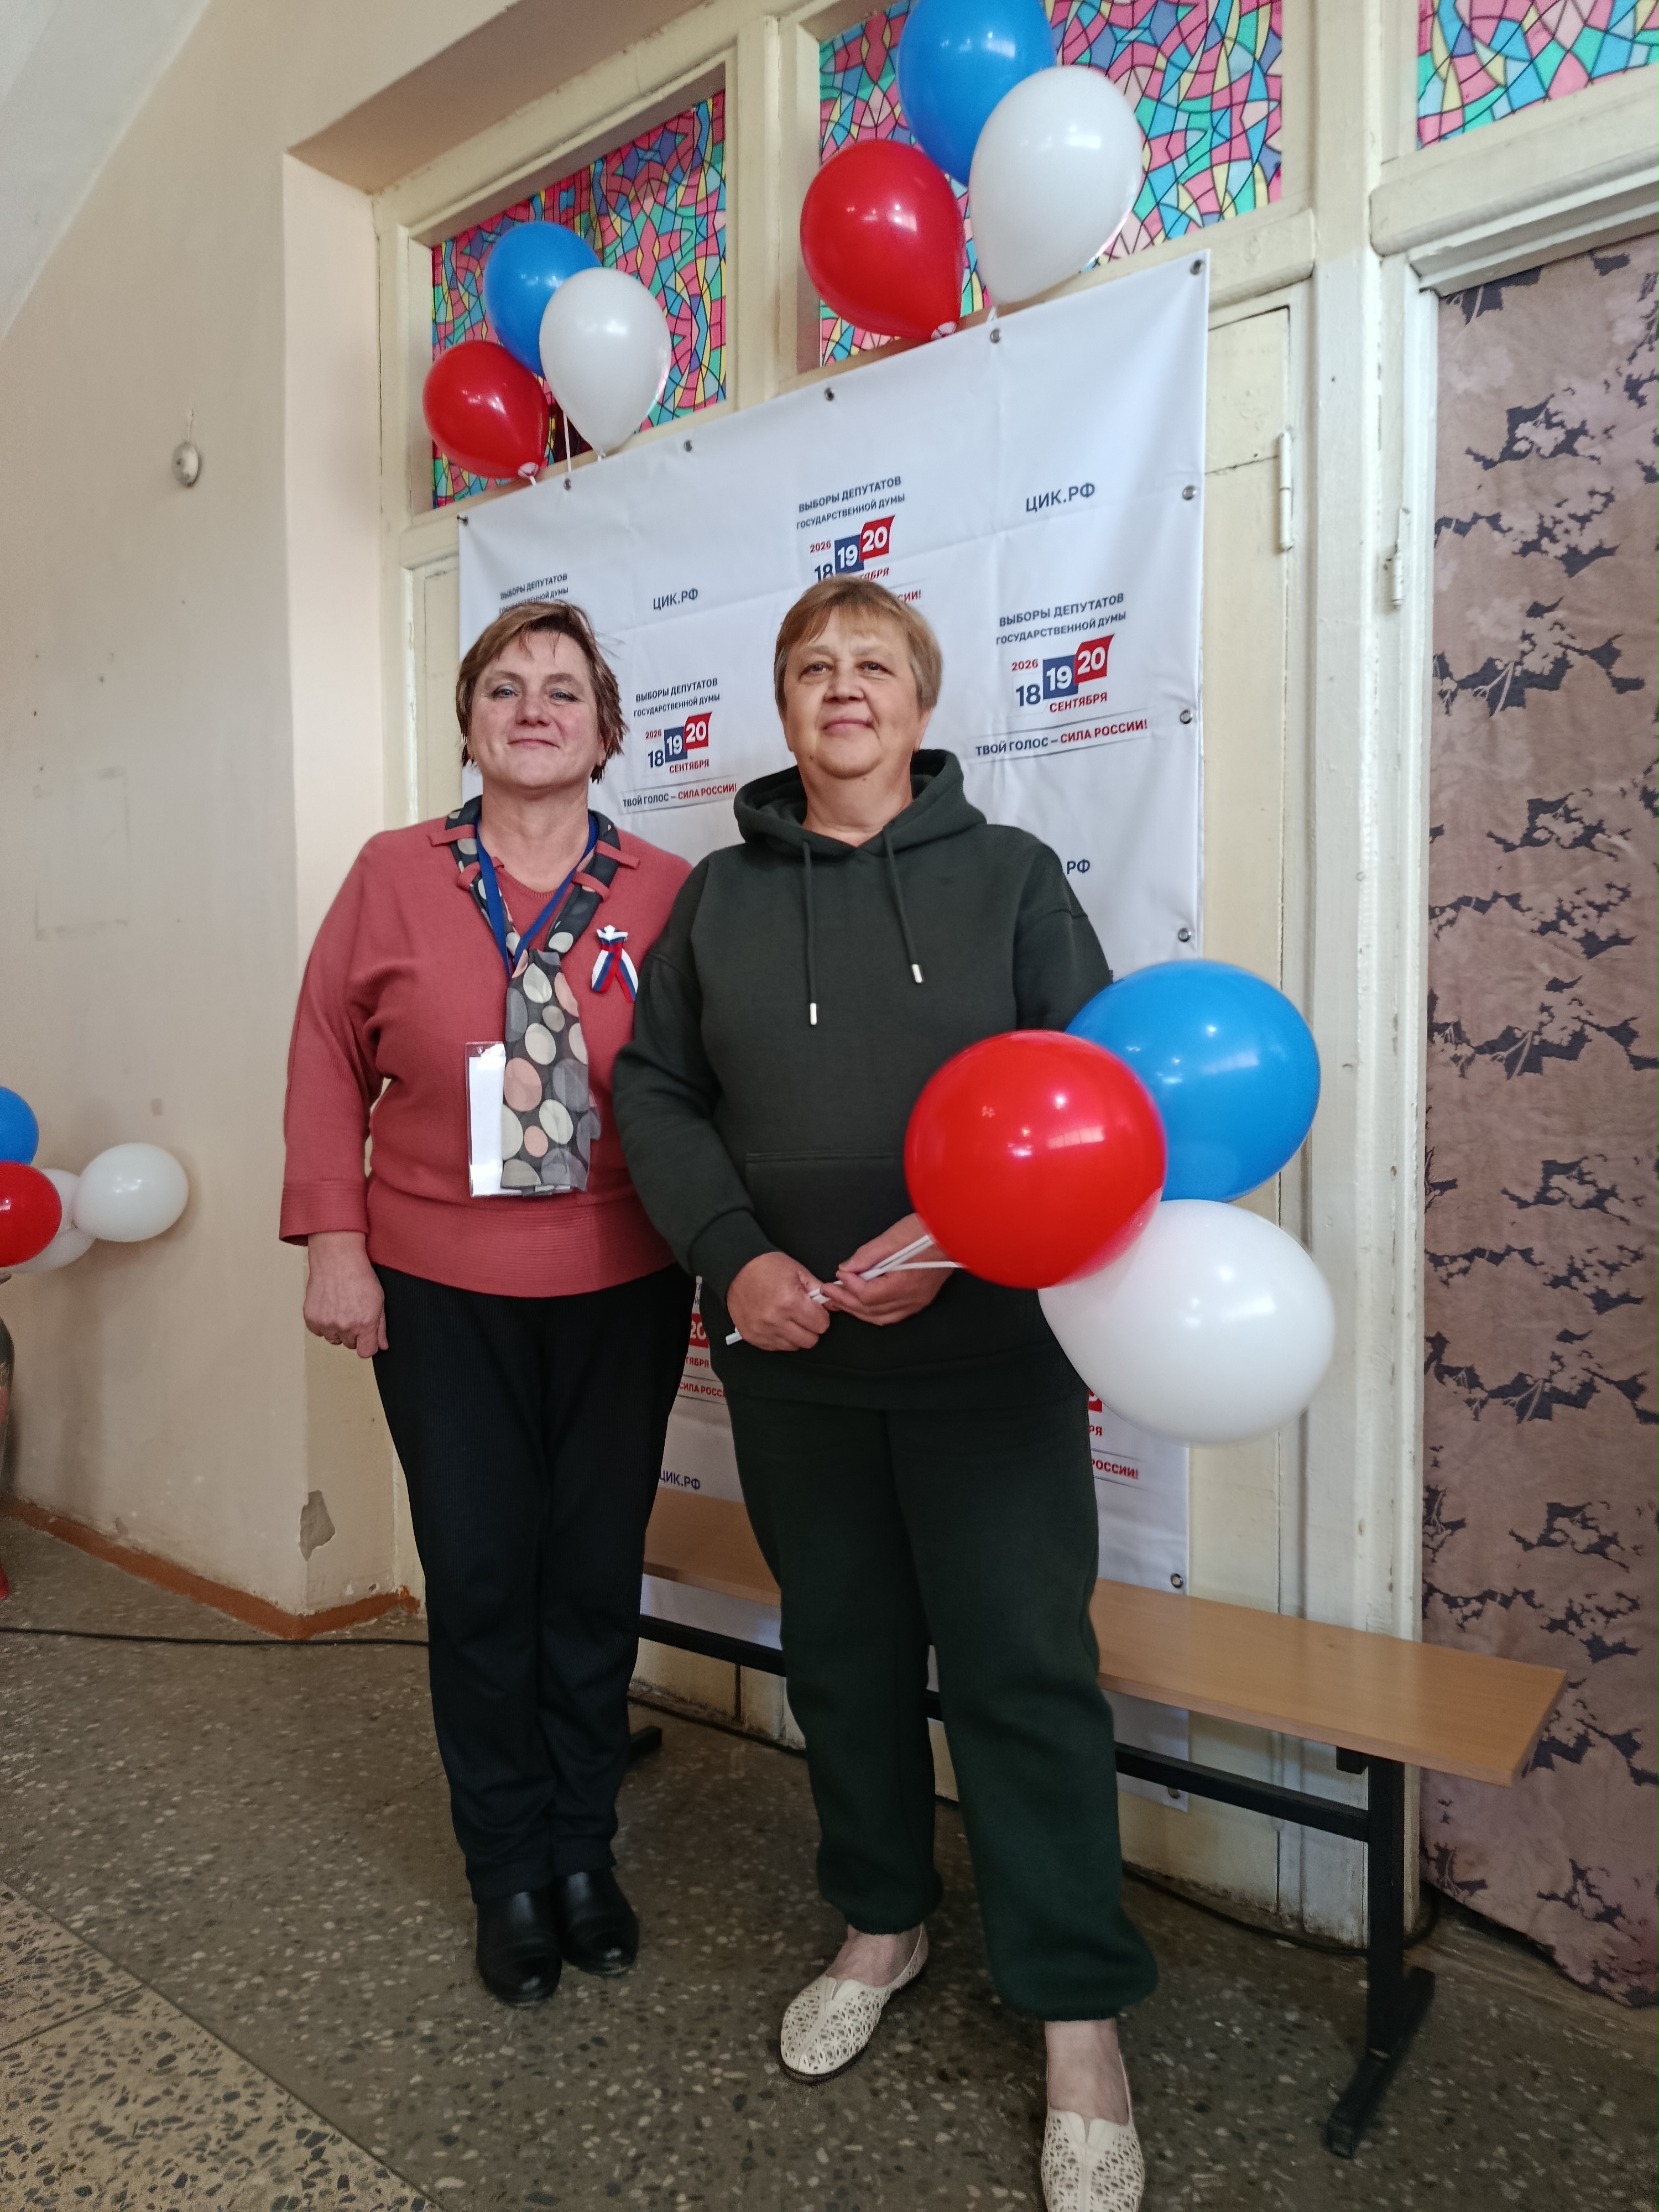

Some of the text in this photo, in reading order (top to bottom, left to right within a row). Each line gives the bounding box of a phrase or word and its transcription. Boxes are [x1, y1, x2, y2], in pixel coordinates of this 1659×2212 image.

[799, 476, 901, 513] ВЫБОРЫ ДЕПУТАТОВ
[1026, 482, 1095, 513] ЦИК.РФ
[796, 493, 905, 530] ГОСУДАРСТВЕННОЙ ДУМЫ
[810, 540, 831, 554] 2026
[862, 526, 888, 554] 20
[837, 544, 858, 568] 19
[814, 562, 834, 581] 18
[500, 573, 567, 600] ВЫБОРЫ ДЕПУТАТОВ
[550, 587, 568, 599] ДУМЫ
[897, 589, 921, 603] СИИ!
[653, 587, 698, 611] ЦИК.РФ
[999, 593, 1124, 627] ВЫБОРЫ ДЕПУТАТОВ
[996, 611, 1126, 645] ГОСУДАРСТВЕННОЙ ДУМЫ
[1011, 659, 1039, 672] 2026
[1077, 646, 1105, 675] 20
[635, 677, 718, 703] ВЫБОРЫ ДЕПУТАТОВ
[1046, 666, 1072, 691] 19
[634, 692, 720, 717] ГОСУДАРСТВЕННОЙ ДУМЫ
[1015, 683, 1041, 707] 18
[1049, 692, 1108, 713] СЕНТЯБРЯ
[645, 729, 662, 740] 2026
[686, 721, 707, 743] 20
[975, 740, 1006, 757] ТВОЙ
[1009, 737, 1048, 752] ГОЛОС
[1060, 729, 1092, 744] СИЛА
[1094, 719, 1147, 738] РОССИИ!
[666, 734, 683, 756] 19
[648, 749, 664, 769] 18
[669, 759, 709, 774] СЕНТЯБРЯ
[623, 795, 642, 807] ТВОЙ
[644, 793, 669, 805] ГОЛОС
[678, 790, 700, 800] СИЛА
[701, 782, 737, 797] РОССИИ!
[690, 1321, 706, 1340] 20
[686, 1357, 709, 1368] ТЯБРЯ
